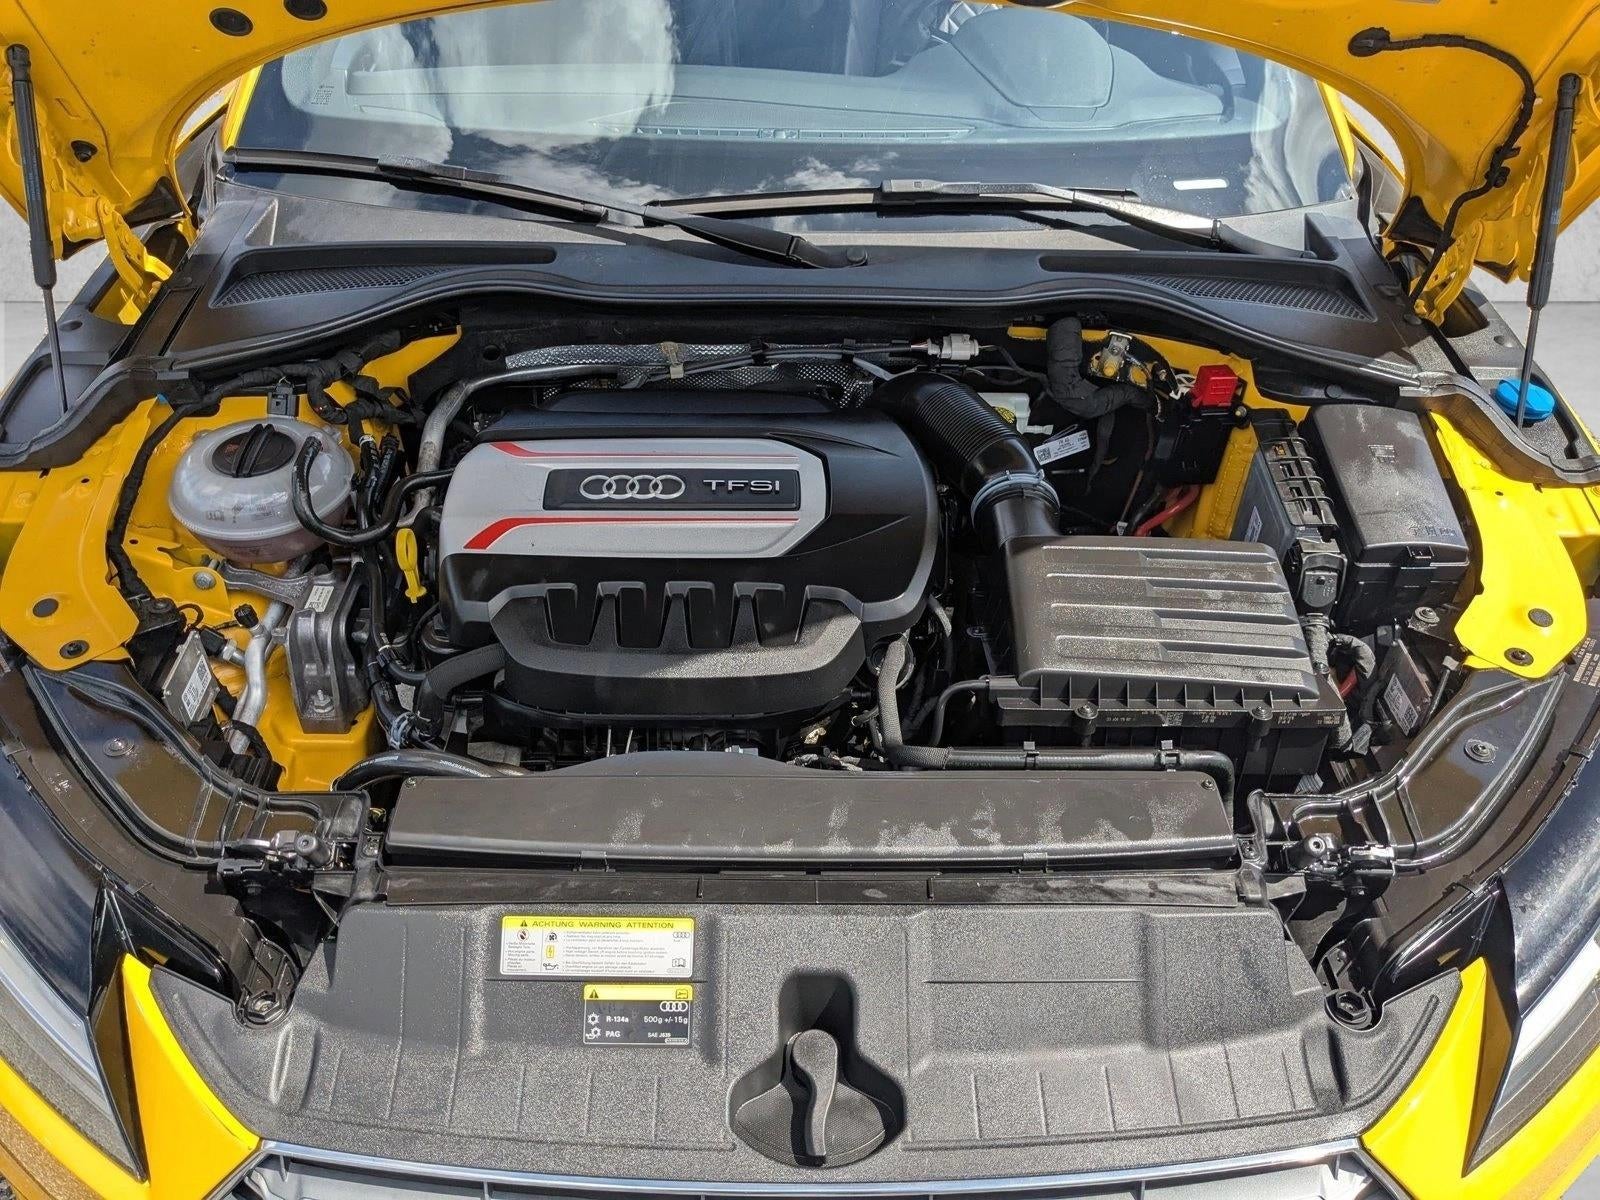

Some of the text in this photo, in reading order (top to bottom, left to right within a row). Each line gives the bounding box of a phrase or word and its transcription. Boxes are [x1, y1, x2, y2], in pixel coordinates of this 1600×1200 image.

[703, 479, 780, 491] TFSI
[532, 920, 574, 928] ACHTUNG
[606, 1015, 629, 1023] R-134a
[643, 1015, 663, 1024] 500g
